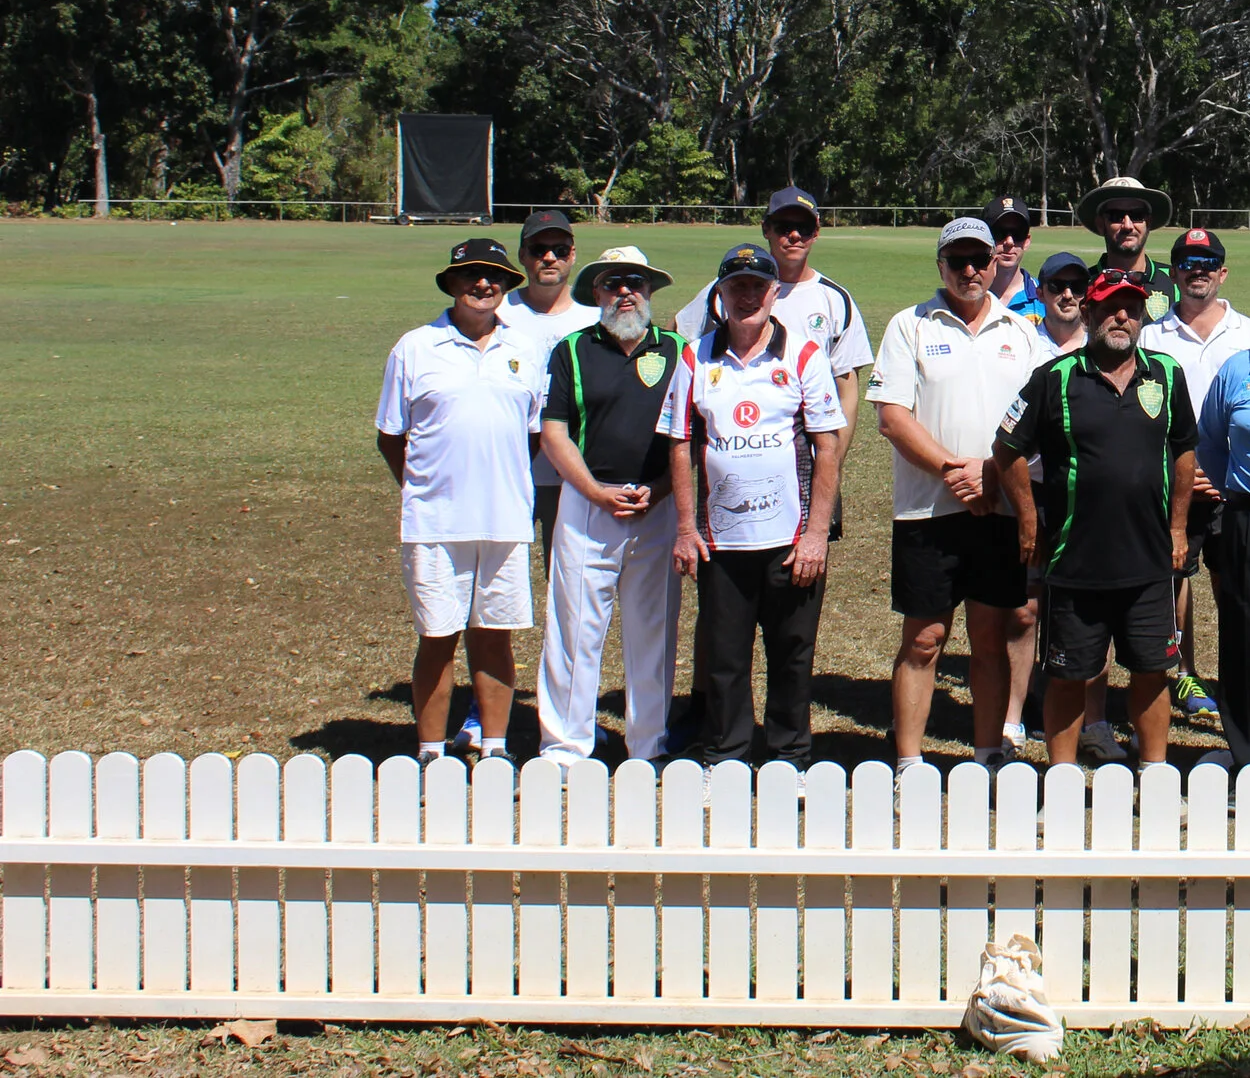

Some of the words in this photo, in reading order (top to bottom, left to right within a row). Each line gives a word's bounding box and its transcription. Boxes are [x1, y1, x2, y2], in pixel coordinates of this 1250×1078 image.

[943, 222, 985, 239] Titleist
[740, 406, 755, 424] R
[715, 433, 783, 452] RYDGES
